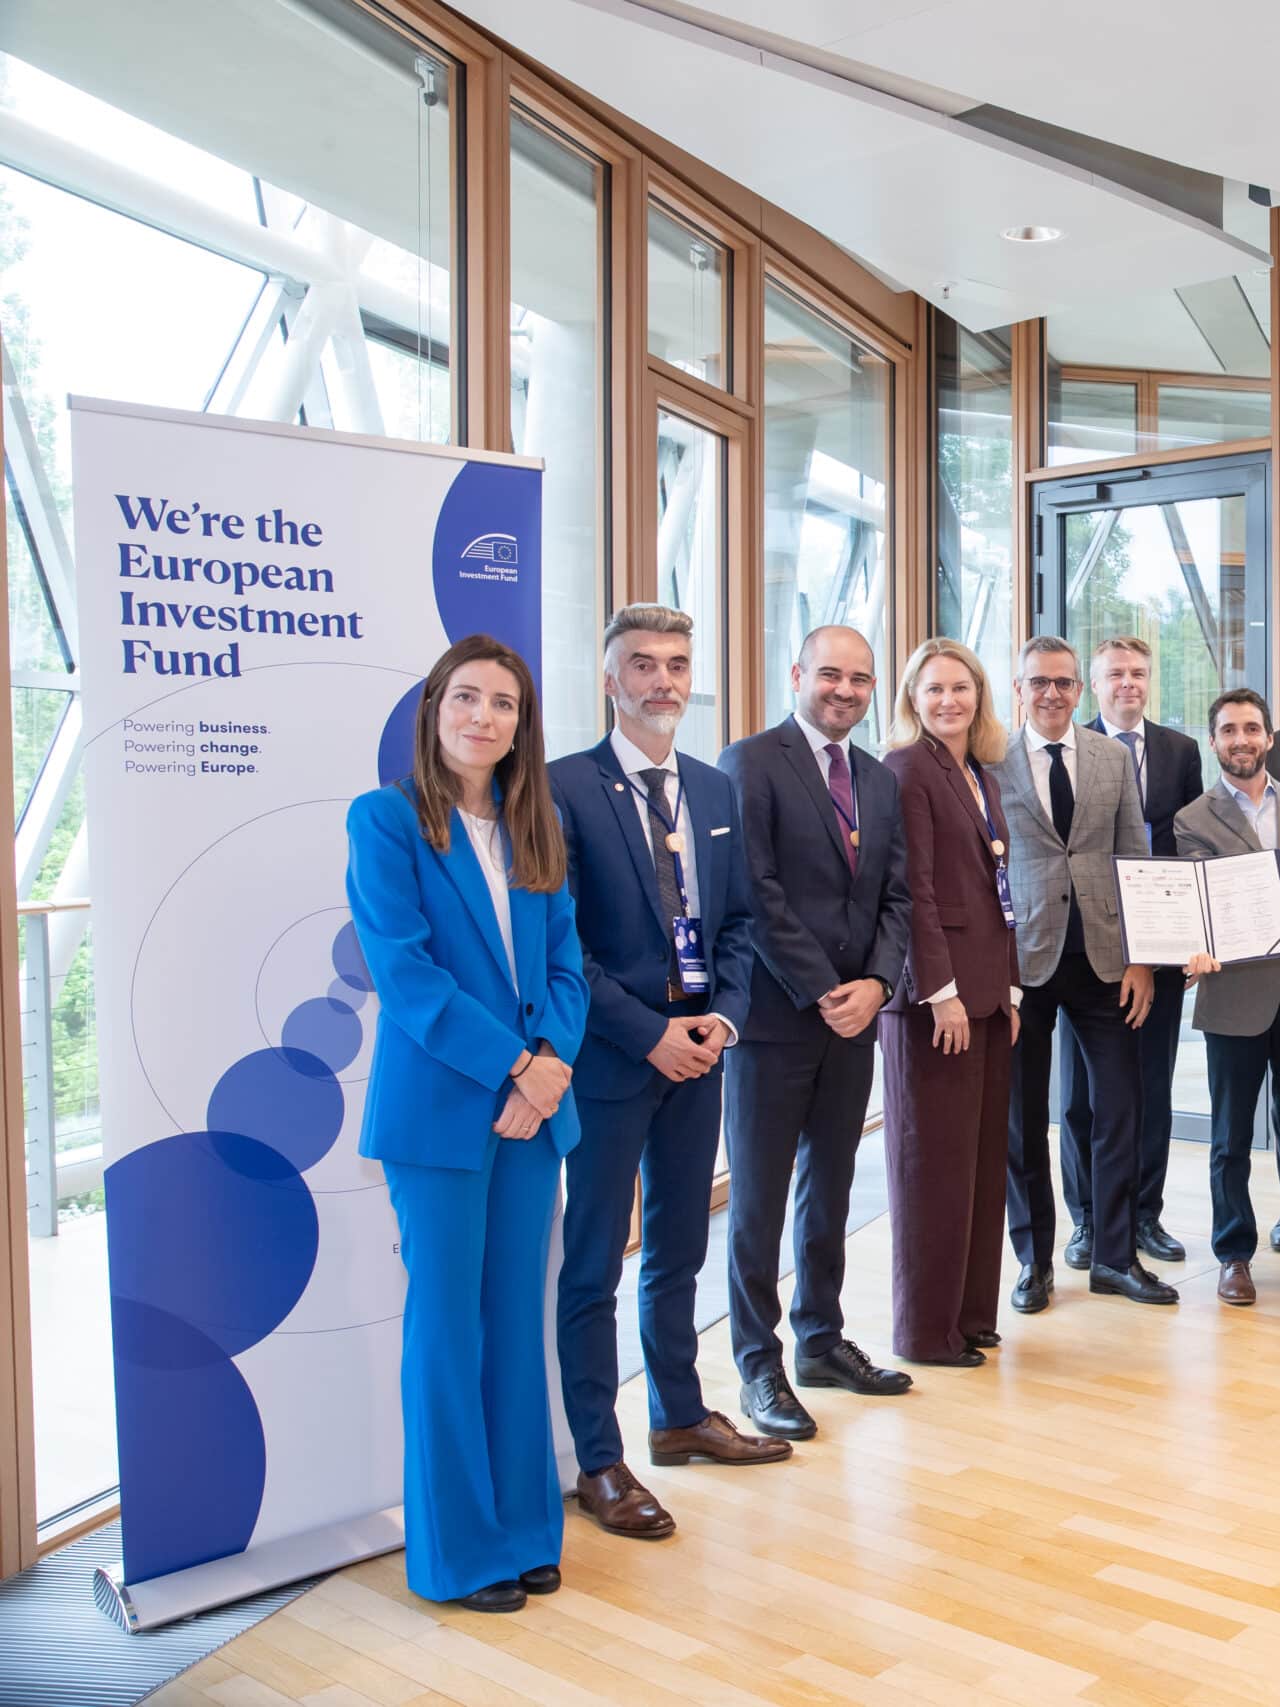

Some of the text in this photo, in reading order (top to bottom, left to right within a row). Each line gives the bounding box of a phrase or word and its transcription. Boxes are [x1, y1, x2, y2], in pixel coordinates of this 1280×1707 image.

[255, 508, 323, 547] the
[117, 542, 334, 595] European
[459, 570, 518, 583] Investment Fund
[484, 564, 518, 575] European
[119, 591, 365, 639] Investment
[121, 639, 243, 678] Fund
[123, 719, 272, 736] Powering business.
[124, 739, 263, 757] Powering change.
[125, 760, 259, 777] Powering Europe.
